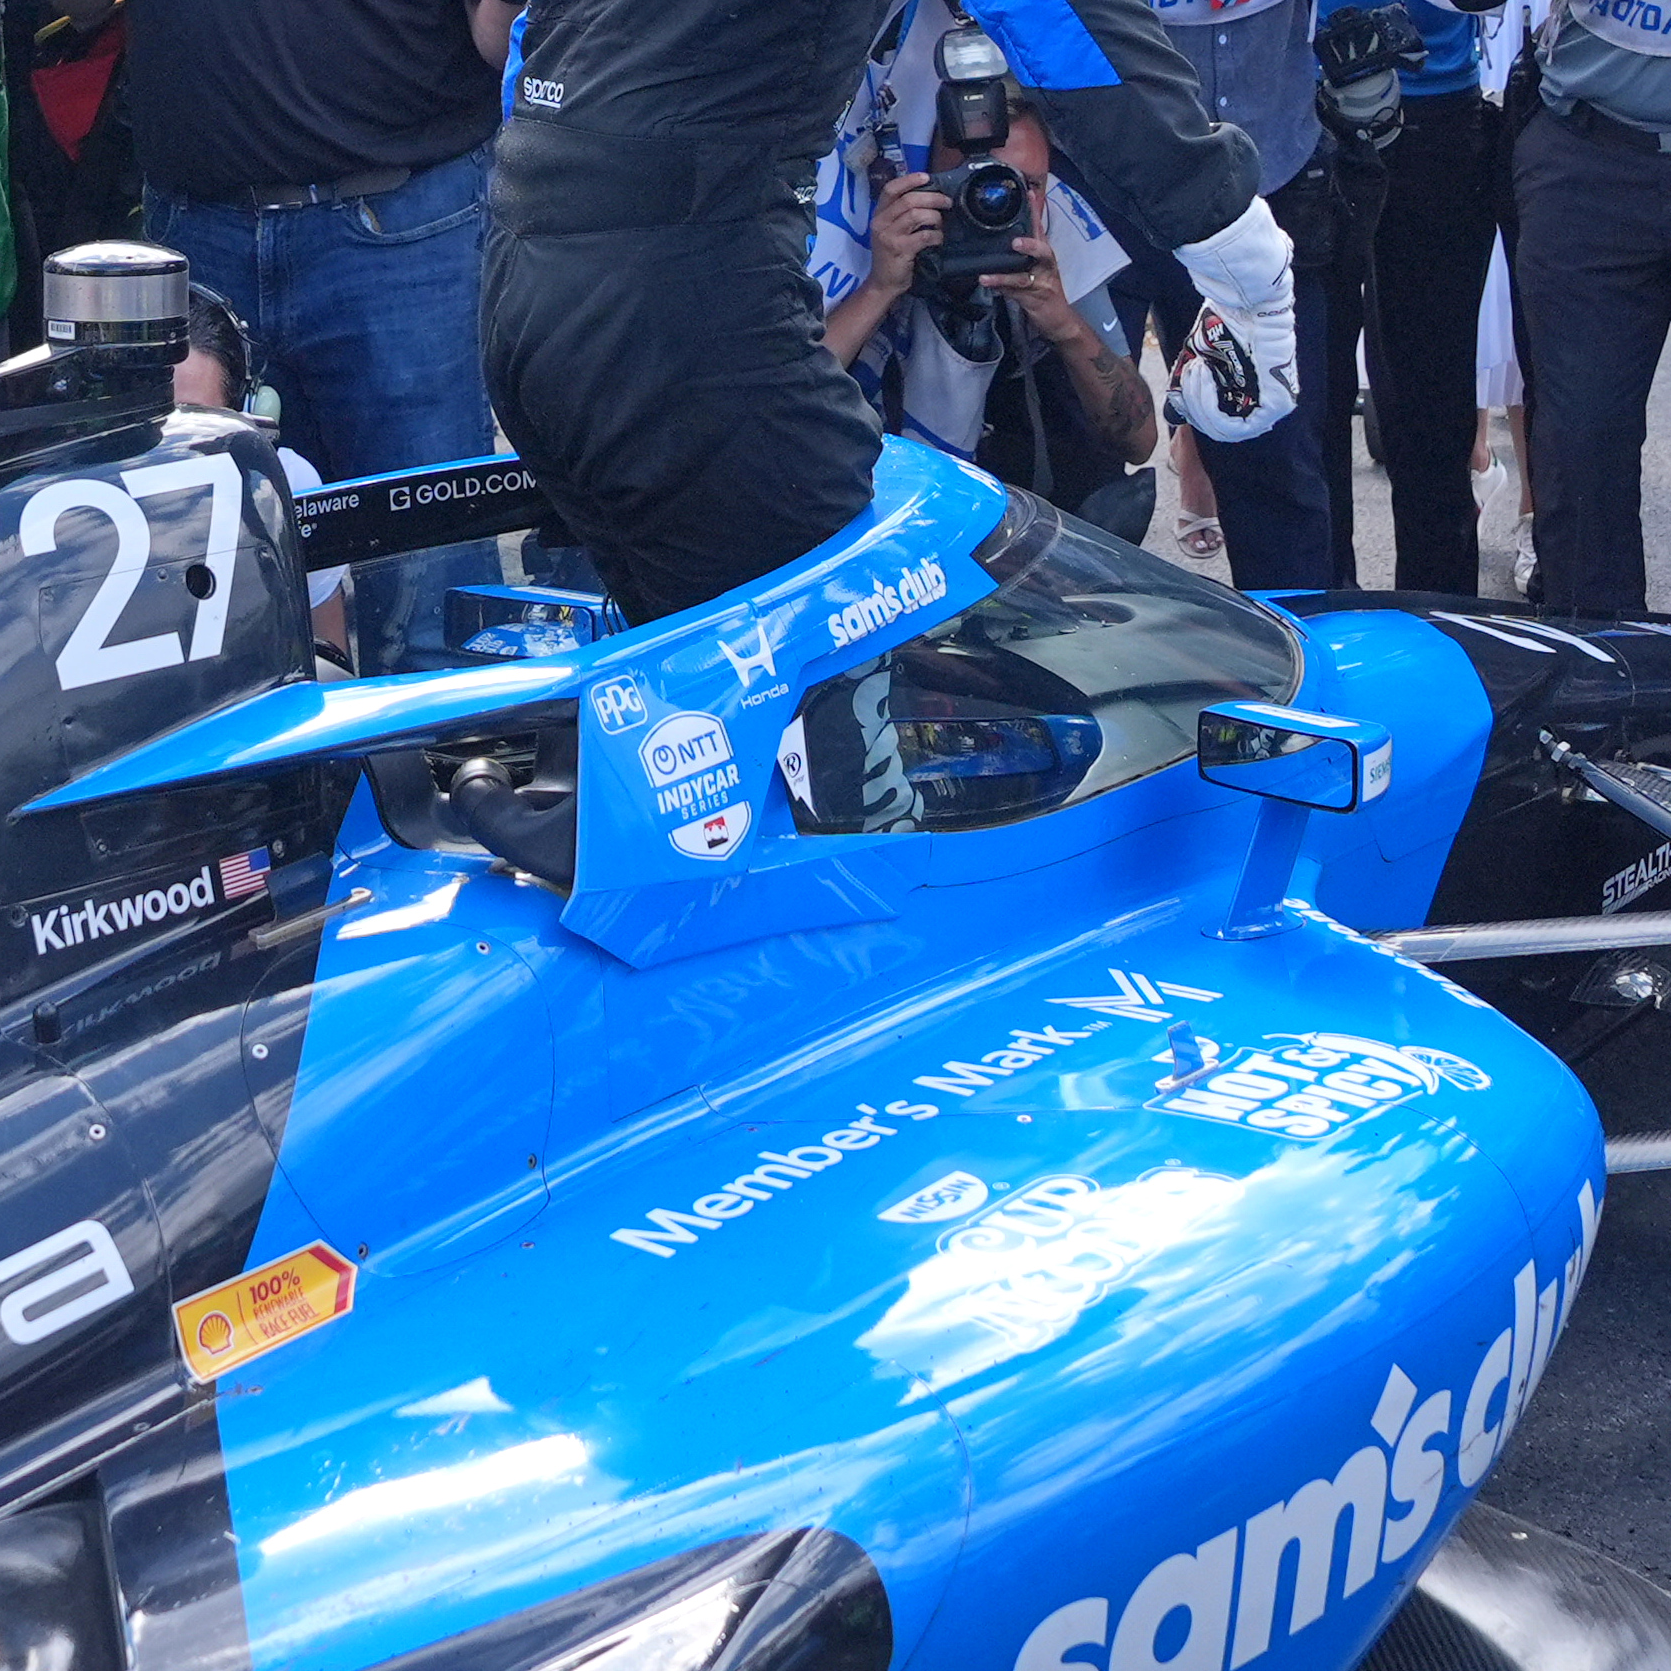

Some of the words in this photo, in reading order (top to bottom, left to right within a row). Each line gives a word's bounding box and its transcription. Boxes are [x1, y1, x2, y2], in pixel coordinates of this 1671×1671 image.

[523, 75, 565, 106] sparco
[415, 469, 538, 507] GOLD.COM
[18, 451, 244, 693] 27
[827, 575, 904, 649] sam's
[897, 554, 948, 615] club
[594, 680, 643, 727] PPG
[740, 681, 790, 710] Honda
[676, 728, 721, 764] NTT
[656, 763, 741, 816] INDYCAR
[680, 790, 731, 821] SERIES
[31, 864, 216, 957] Kirkwood
[1248, 1056, 1422, 1139] SPICY
[609, 1098, 939, 1260] Member's
[913, 1020, 1094, 1102] Mark
[897, 1177, 979, 1221] NISSIN
[247, 1267, 302, 1307] 100%
[251, 1285, 306, 1320] RENEWABLE
[258, 1312, 291, 1343] RACE
[288, 1304, 322, 1329] FUEL
[1013, 1363, 1452, 1671] sam's
